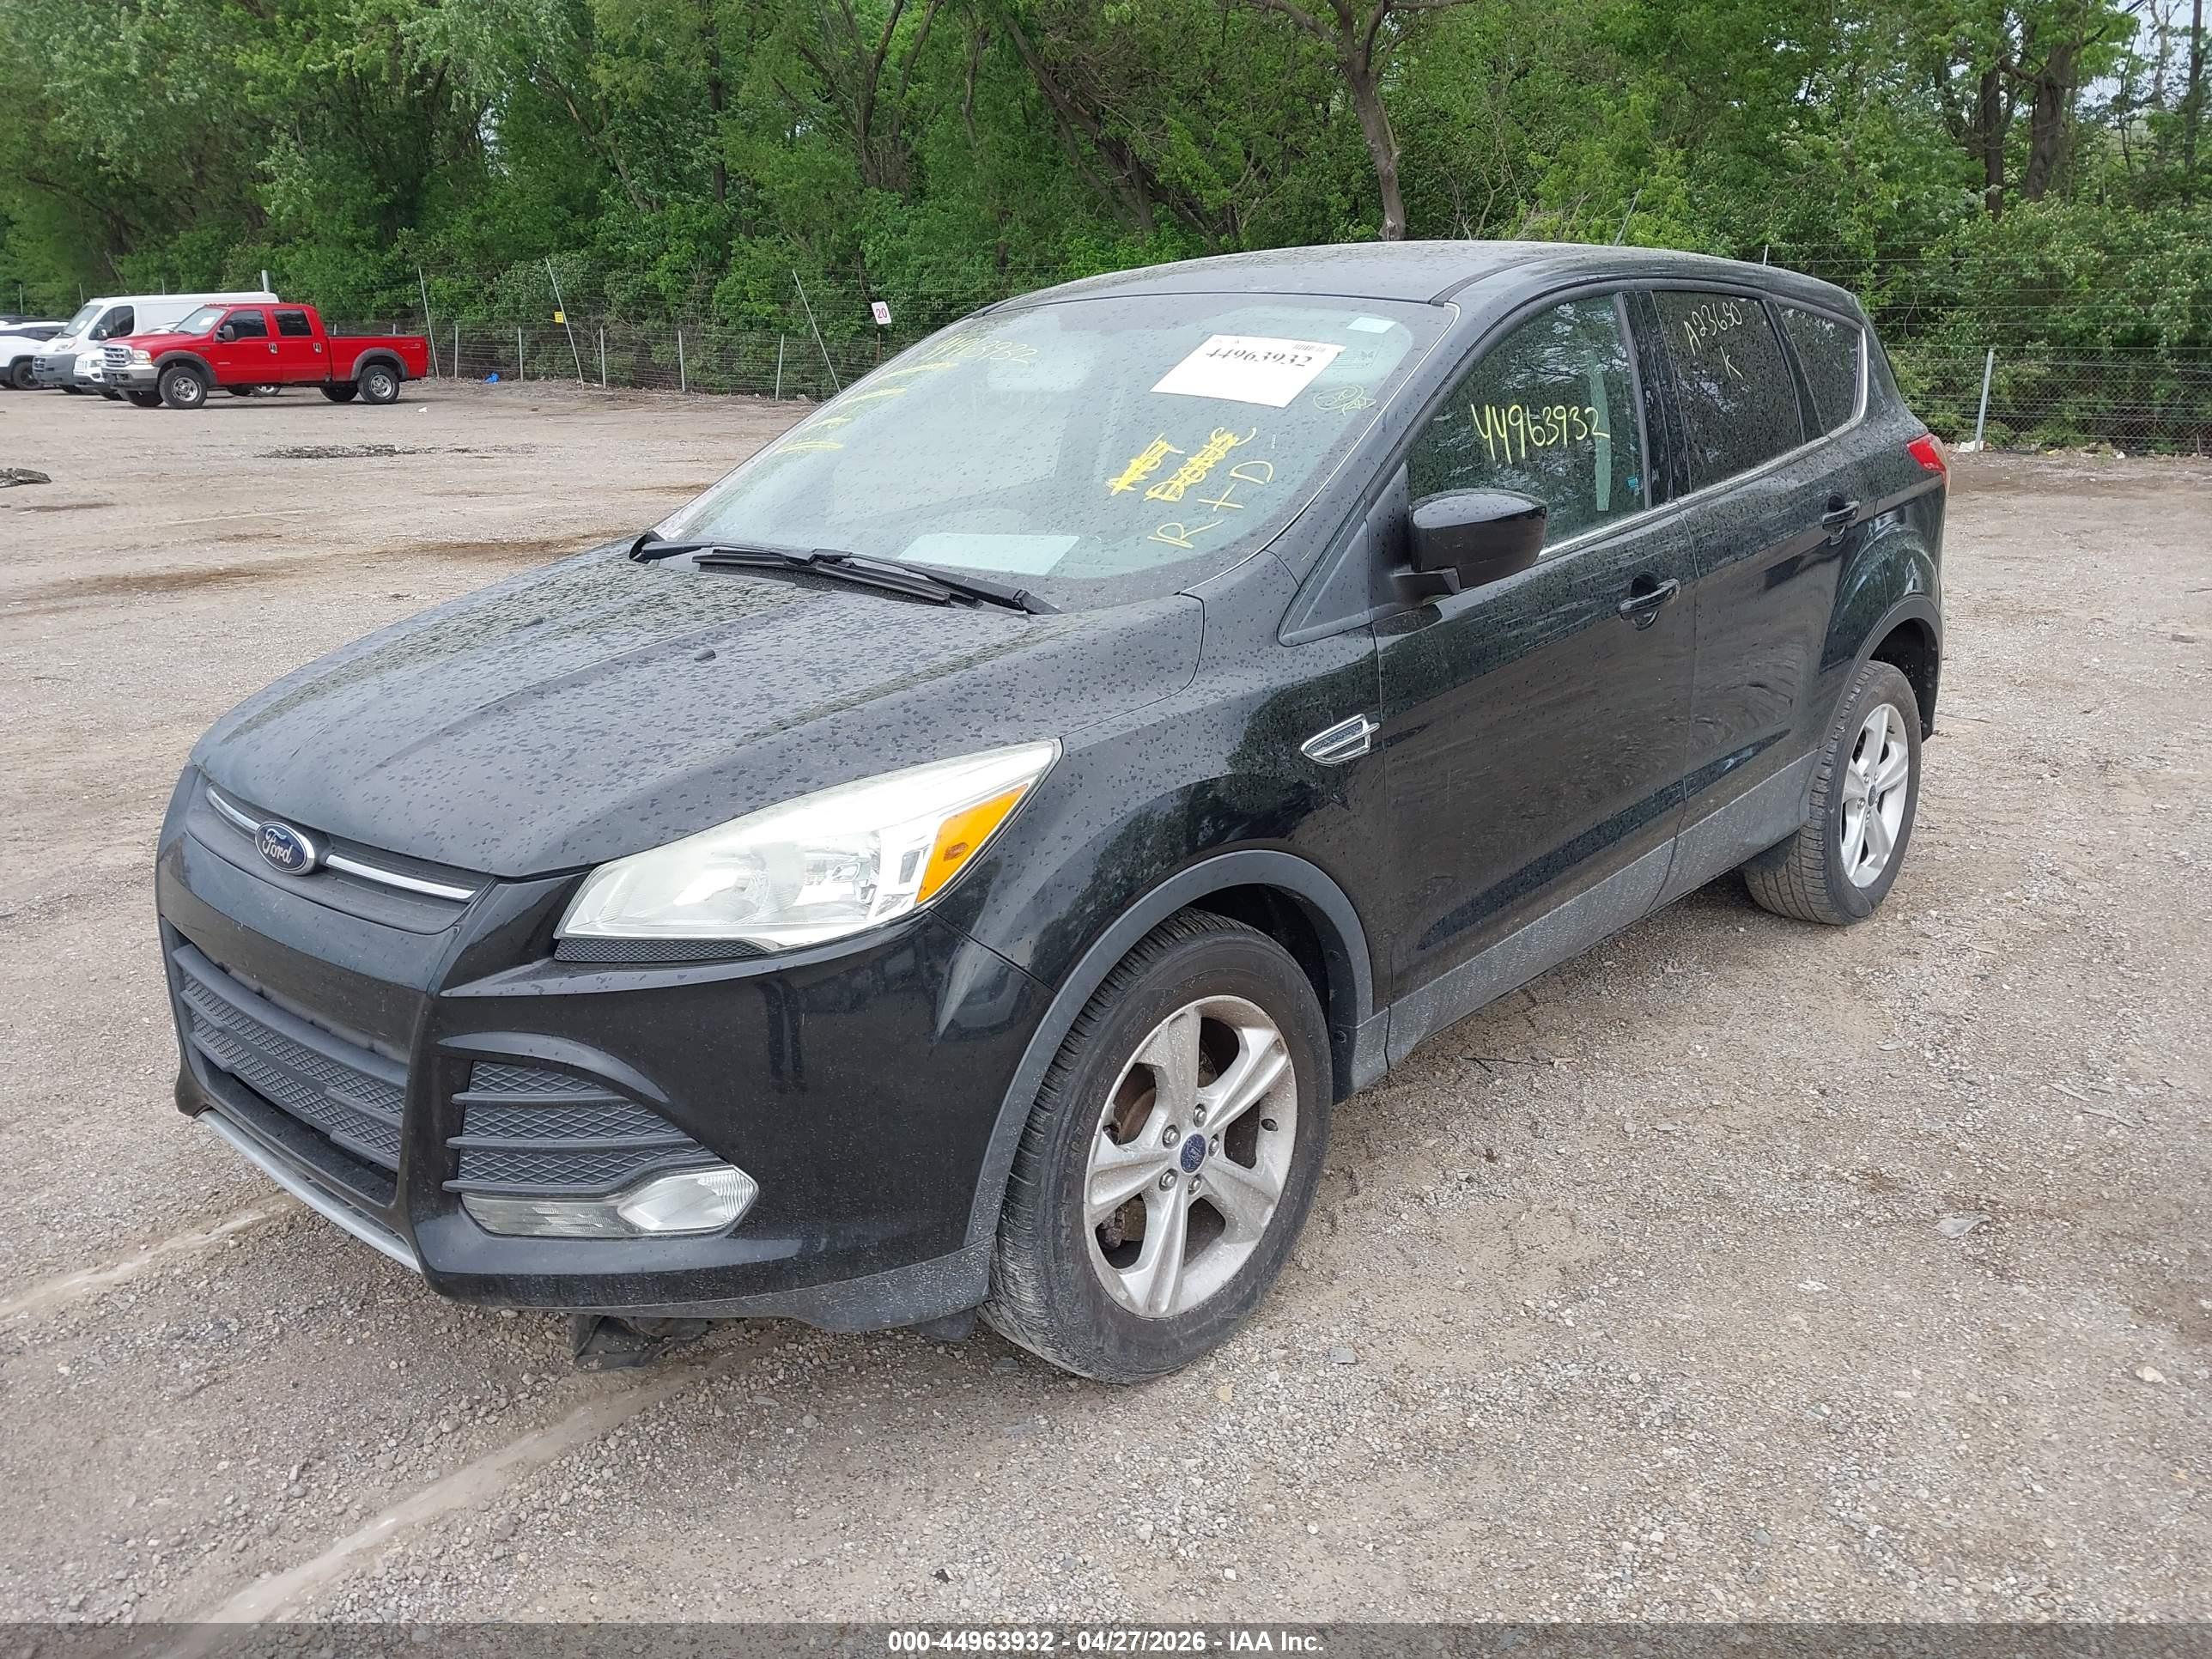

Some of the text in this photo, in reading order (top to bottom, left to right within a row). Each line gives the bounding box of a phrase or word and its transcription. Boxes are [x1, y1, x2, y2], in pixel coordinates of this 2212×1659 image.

[876, 307, 888, 319] 20
[1206, 347, 1313, 368] 44963932
[1470, 404, 1611, 465] 44963932
[262, 828, 294, 864] Ford
